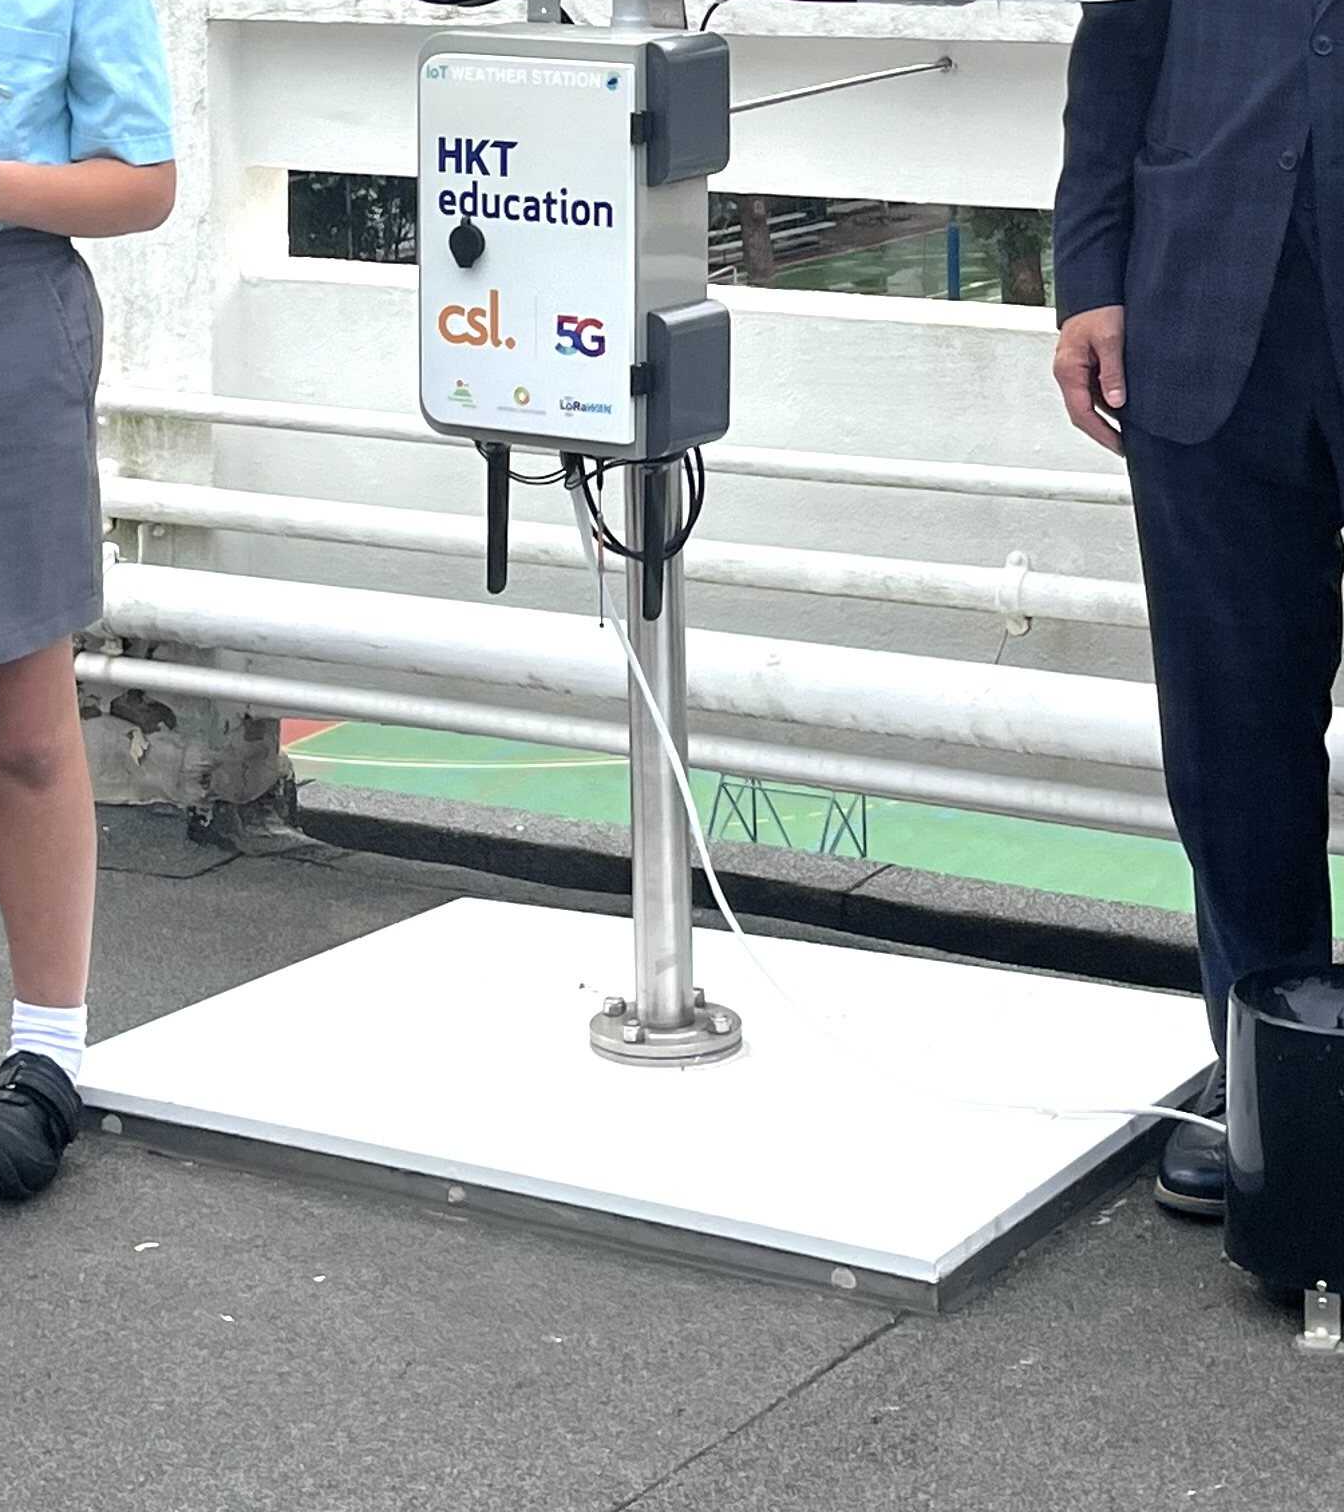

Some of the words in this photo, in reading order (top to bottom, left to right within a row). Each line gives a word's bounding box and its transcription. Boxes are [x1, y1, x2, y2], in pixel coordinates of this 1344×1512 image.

[426, 65, 448, 80] IoT
[451, 66, 527, 84] WEATHER
[531, 69, 602, 88] STATION
[438, 136, 518, 177] HKT
[438, 180, 613, 228] education
[438, 289, 516, 350] csl.
[555, 314, 606, 358] 5G
